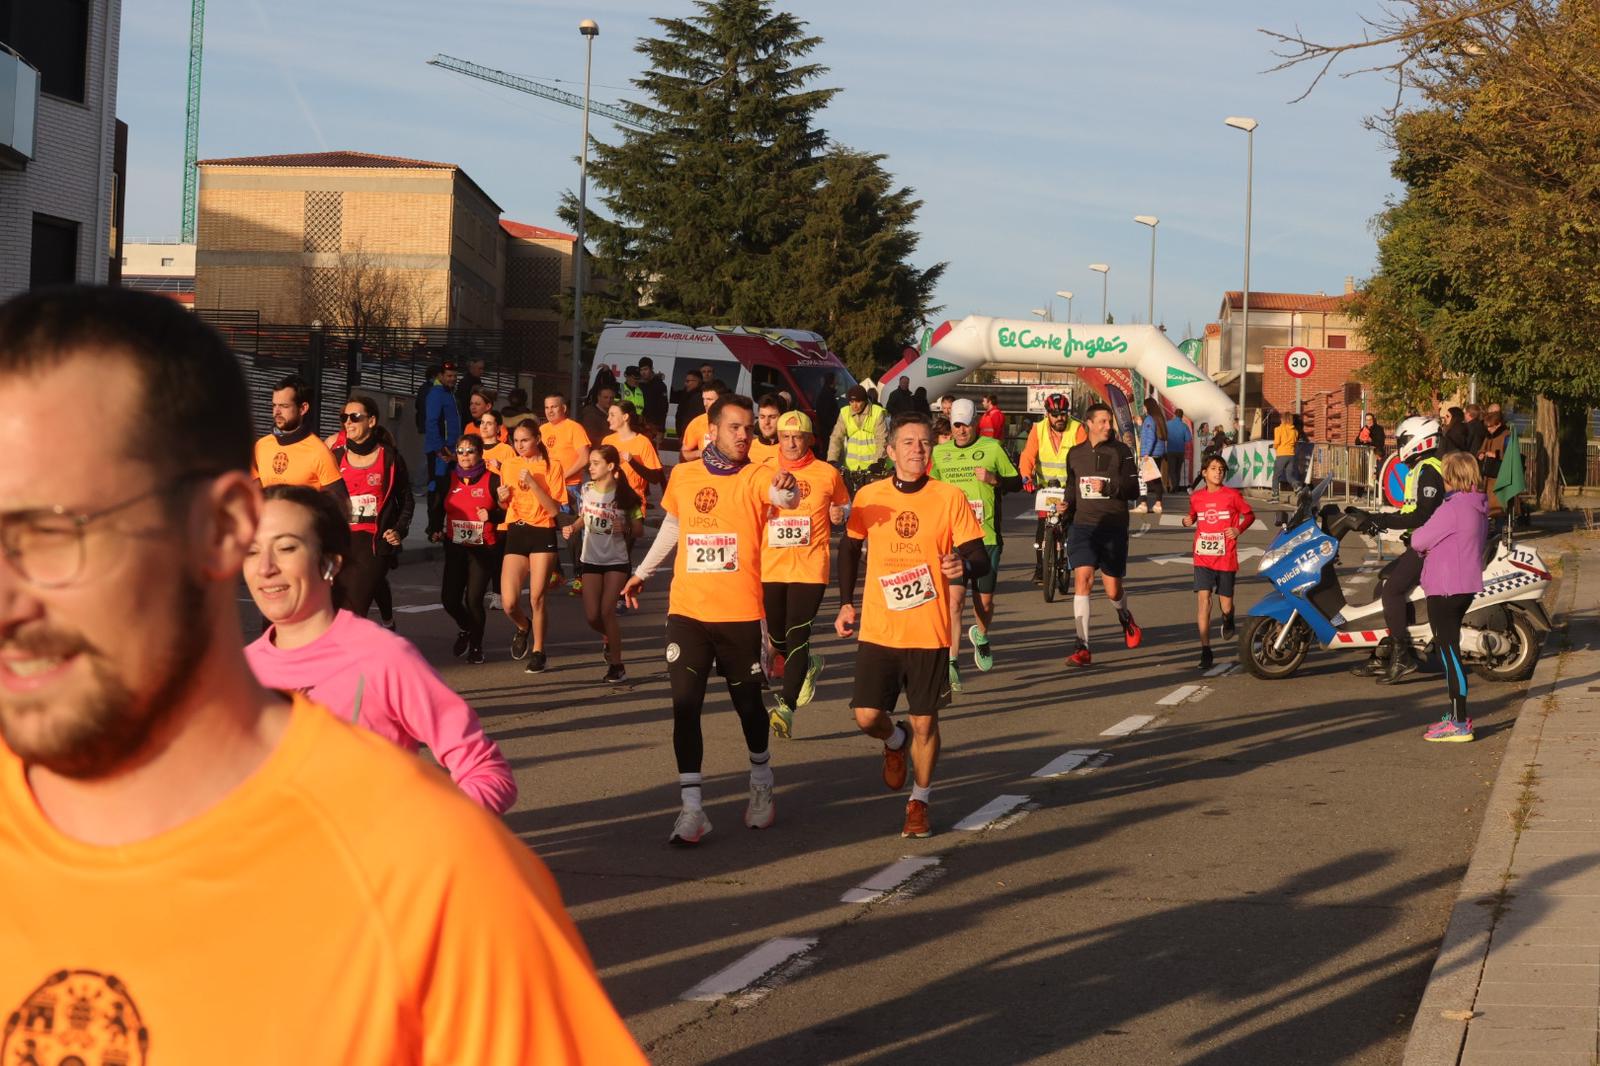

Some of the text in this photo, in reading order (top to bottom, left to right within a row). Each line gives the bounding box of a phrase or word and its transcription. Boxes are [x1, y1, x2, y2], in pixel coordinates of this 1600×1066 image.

[660, 332, 714, 342] AMBULANCIA
[998, 327, 1128, 358] El Corte Inglés
[1291, 357, 1308, 368] 30
[589, 515, 607, 528] 118
[688, 516, 719, 529] UPSA
[460, 529, 473, 539] 39
[777, 527, 802, 539] 383
[890, 542, 922, 554] UPSA
[1201, 541, 1219, 550] 522
[696, 547, 725, 563] 281
[1511, 549, 1534, 565] 112
[893, 580, 924, 601] 322
